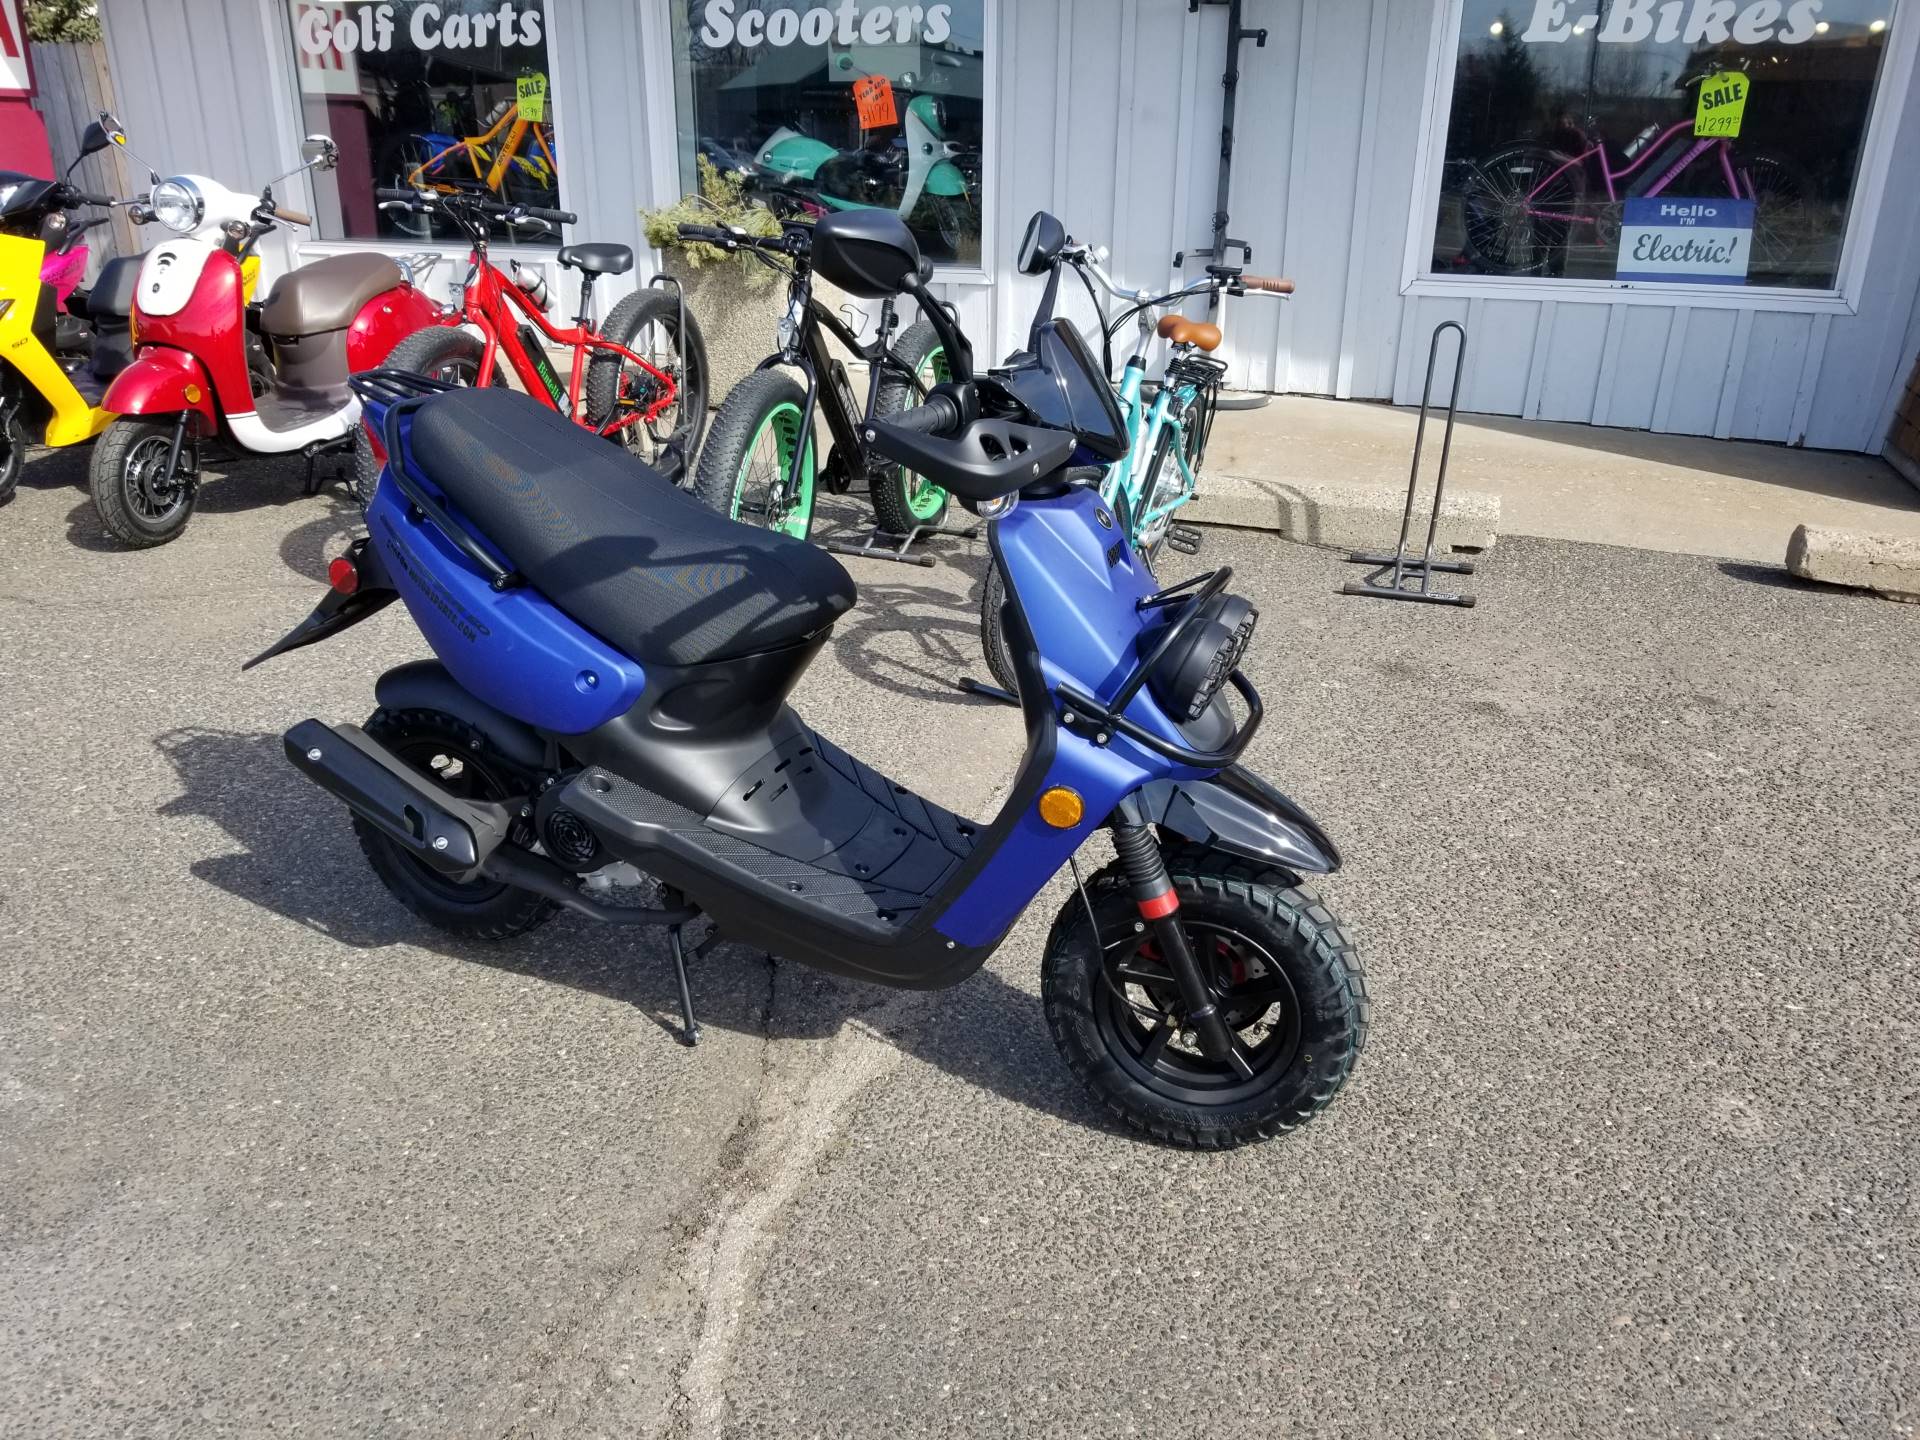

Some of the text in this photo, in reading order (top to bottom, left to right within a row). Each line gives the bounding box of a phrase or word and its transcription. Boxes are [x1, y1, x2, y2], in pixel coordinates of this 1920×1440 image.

[299, 2, 542, 54] Golf Carts
[701, 0, 951, 47] Scooters
[1521, 0, 1823, 44] E-Bikes
[518, 80, 543, 99] SALE
[1702, 82, 1743, 110] SALE
[1660, 204, 1718, 217] Hello
[1680, 217, 1696, 226] I'M
[1633, 233, 1738, 264] Electric!
[538, 360, 561, 401] Bintelli
